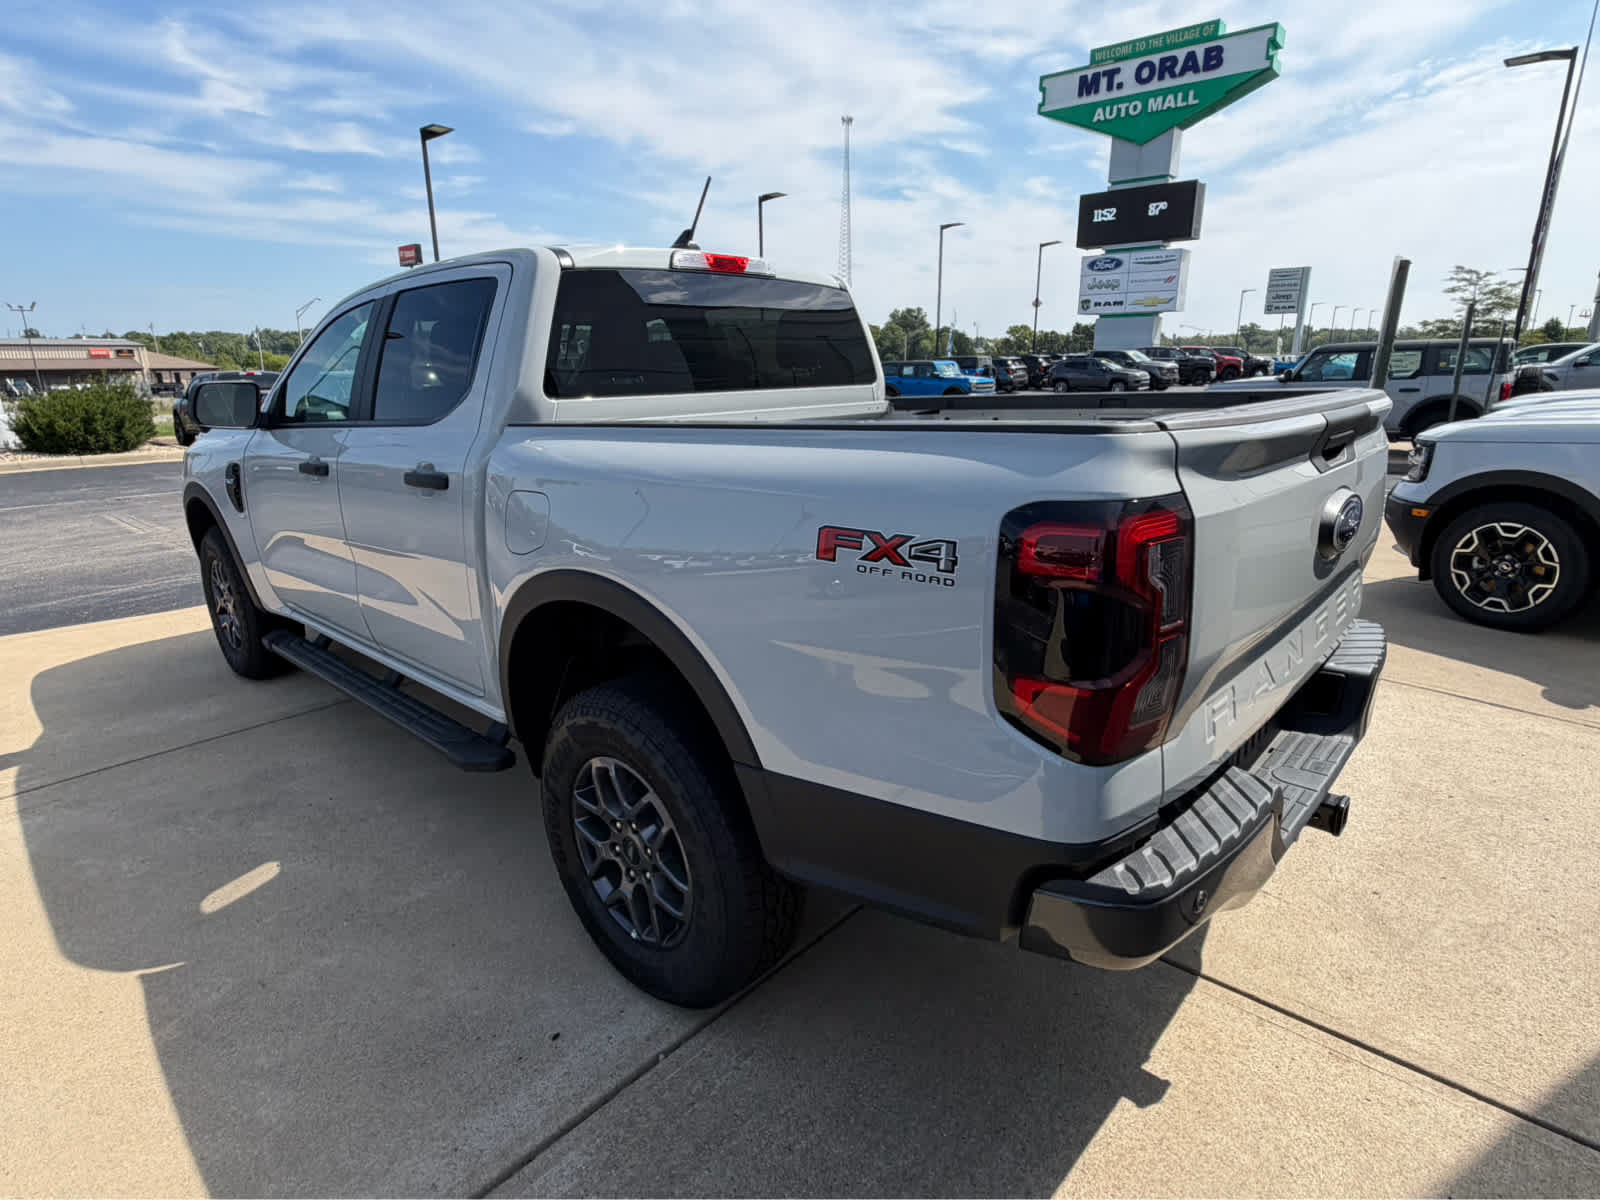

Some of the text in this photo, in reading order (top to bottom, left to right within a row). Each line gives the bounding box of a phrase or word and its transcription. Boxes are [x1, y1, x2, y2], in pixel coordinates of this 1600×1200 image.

[1095, 24, 1216, 61] WELCOME TO THE VILLAGE OF
[1077, 45, 1225, 98] MT. ORAB
[1092, 90, 1199, 123] AUTO MALL
[1094, 300, 1124, 308] RAM
[816, 525, 958, 574] FX4
[856, 564, 955, 587] OFF ROAD
[1203, 568, 1362, 745] RANGER
